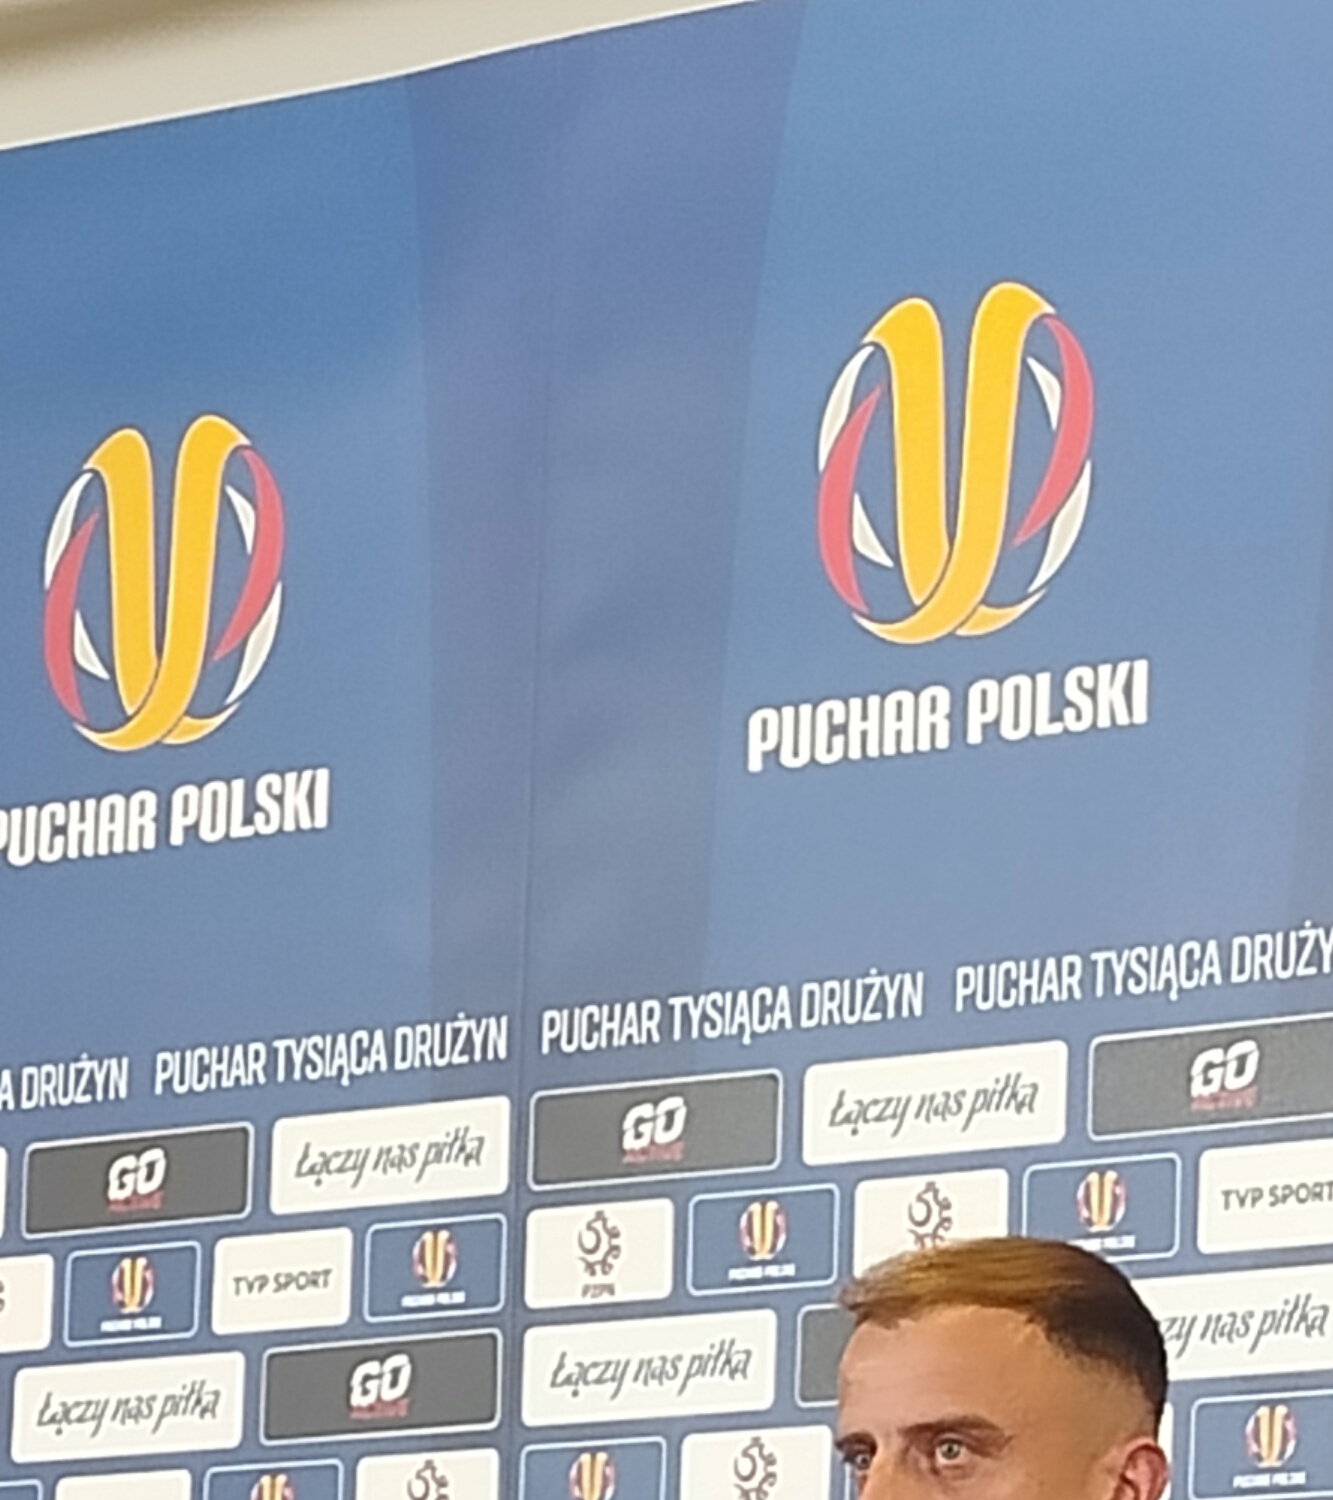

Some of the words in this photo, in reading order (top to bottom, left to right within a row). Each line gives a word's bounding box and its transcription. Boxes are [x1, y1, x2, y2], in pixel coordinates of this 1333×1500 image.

[748, 685, 950, 773] PUCHAR
[966, 659, 1148, 745] POLSKI
[0, 790, 157, 866] UCHAR
[170, 768, 329, 846] POLSKI
[955, 954, 1082, 1011] PUCHAR
[1090, 939, 1221, 1000] TYSIĄCA
[541, 1000, 661, 1055] PUCHAR
[668, 986, 792, 1045] TYSIĄCA
[800, 967, 923, 1028] DRUŻYN
[21, 1054, 128, 1109] DRUŻYN
[155, 1042, 266, 1095] PUCHAR
[272, 1029, 387, 1086] TYSIĄCA
[394, 1013, 508, 1070] DRUŻYN
[1190, 1039, 1259, 1099] GO
[622, 1096, 687, 1151] GO
[827, 1089, 912, 1138] Łączy
[914, 1089, 963, 1120] nas
[962, 1071, 1039, 1132] piłka
[108, 1146, 166, 1200] GO
[295, 1143, 367, 1187] Łączy
[377, 1139, 419, 1175] nas
[415, 1125, 485, 1182] piłka
[1221, 1188, 1263, 1211] TVP
[233, 1275, 269, 1296] TVP
[272, 1267, 333, 1294] SPORT
[1200, 1307, 1253, 1340] nas
[1249, 1293, 1330, 1354] piłka
[350, 1353, 412, 1407] GO
[550, 1352, 630, 1399] Łączy
[633, 1354, 682, 1387] nas
[678, 1338, 753, 1395] piłka
[37, 1392, 108, 1437] Łączy
[111, 1396, 154, 1423] nas
[152, 1380, 221, 1433] piłka
